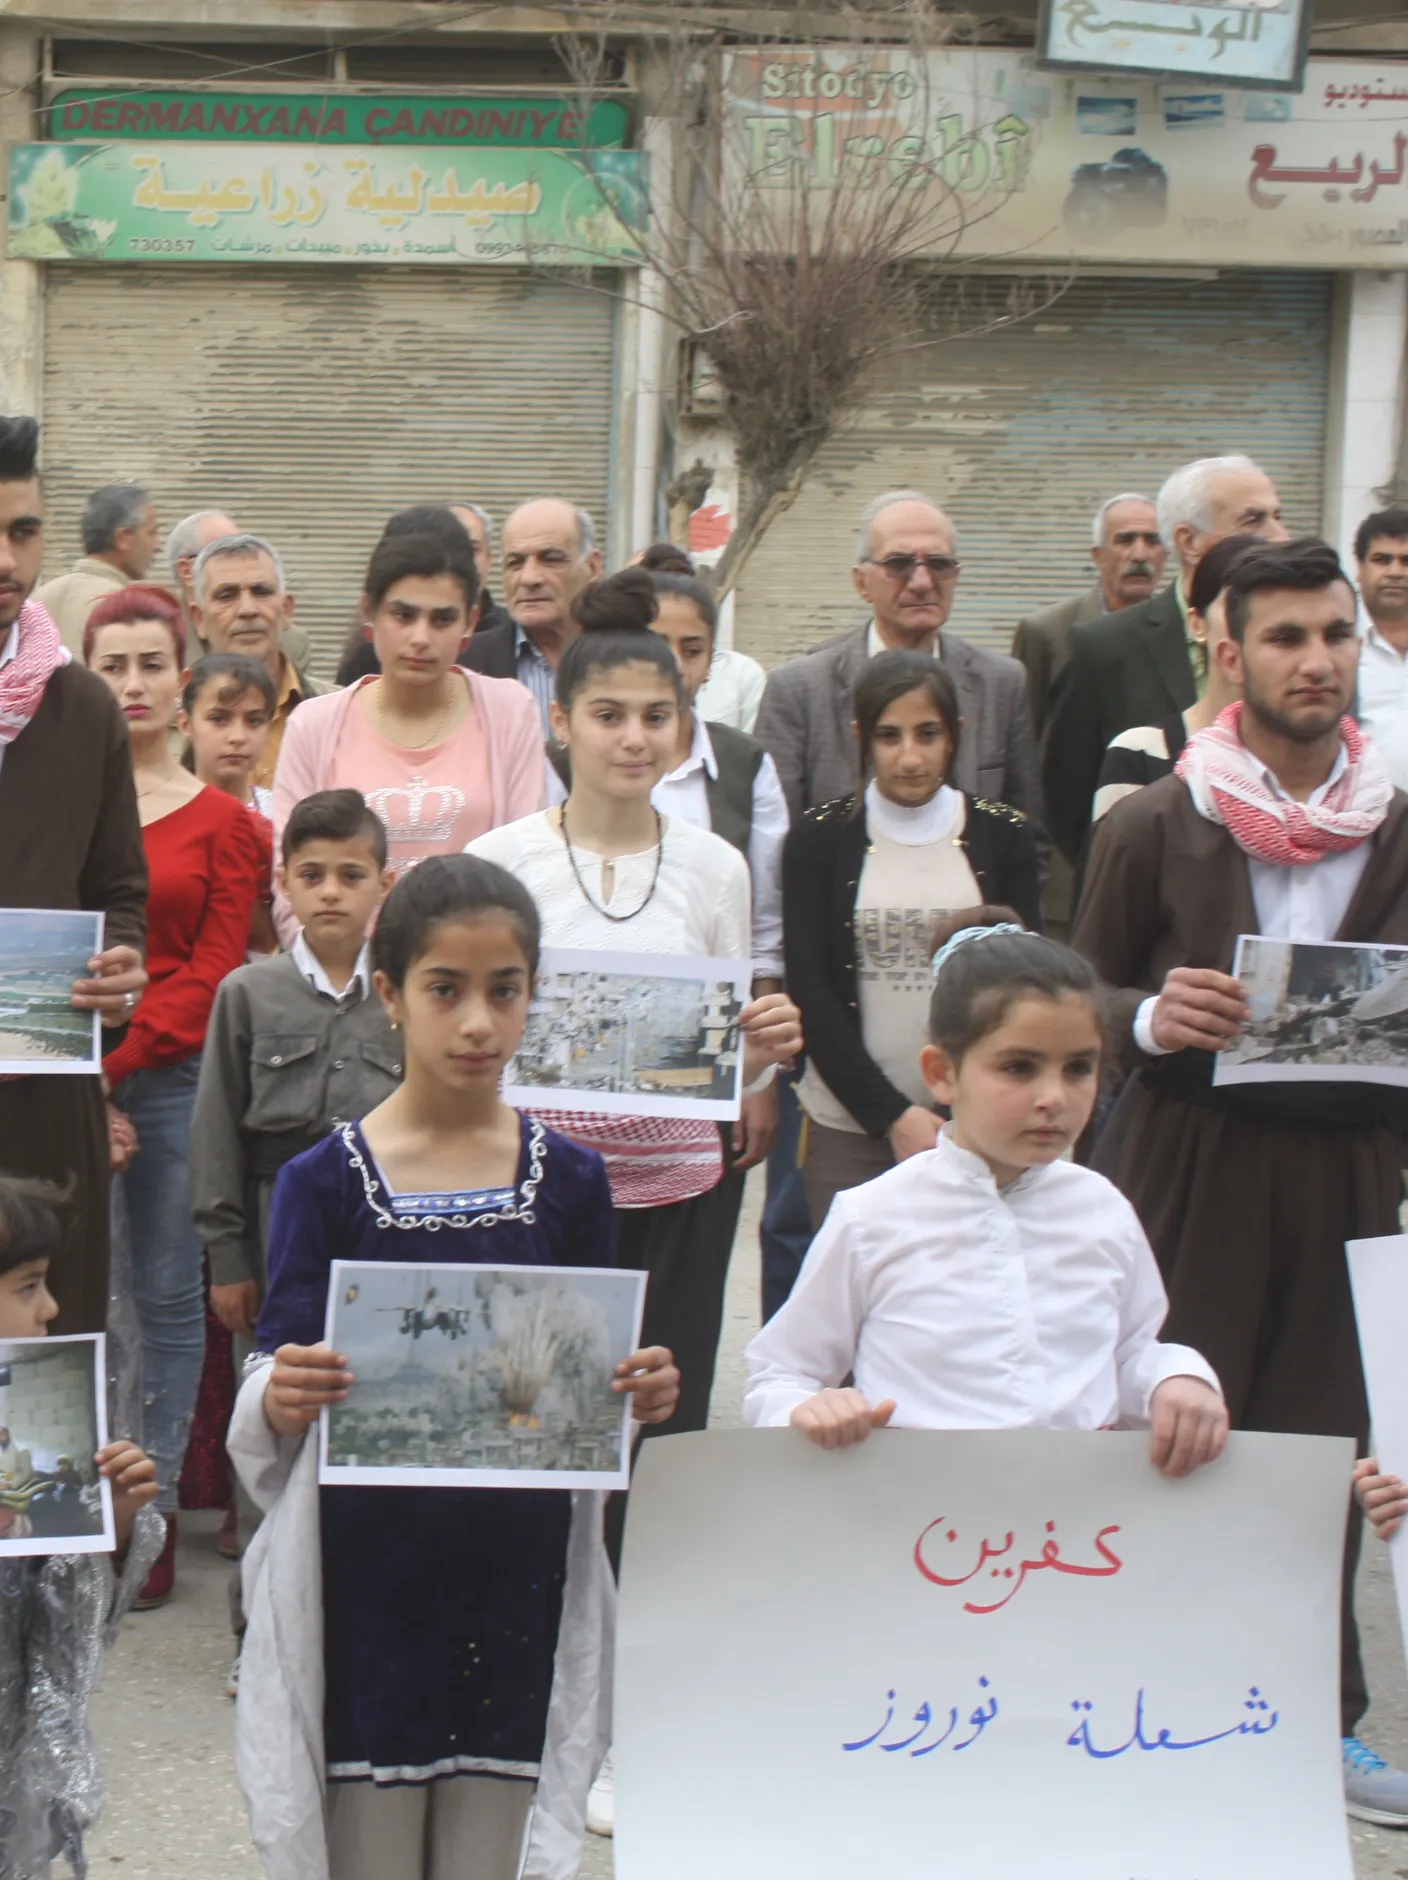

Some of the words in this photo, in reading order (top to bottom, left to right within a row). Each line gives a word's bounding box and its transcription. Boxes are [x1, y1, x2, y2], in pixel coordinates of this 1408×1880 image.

[62, 99, 348, 136] DERMANXANA
[1324, 76, 1408, 109] ستوديو
[130, 155, 328, 227] زراعية
[347, 162, 542, 229] صيدلية
[1248, 130, 1408, 210] لربيع
[129, 238, 195, 252] 730357
[913, 1515, 1123, 1614] كفرين
[841, 1674, 999, 1758] نوروز
[1065, 1685, 1280, 1759] شعلة
